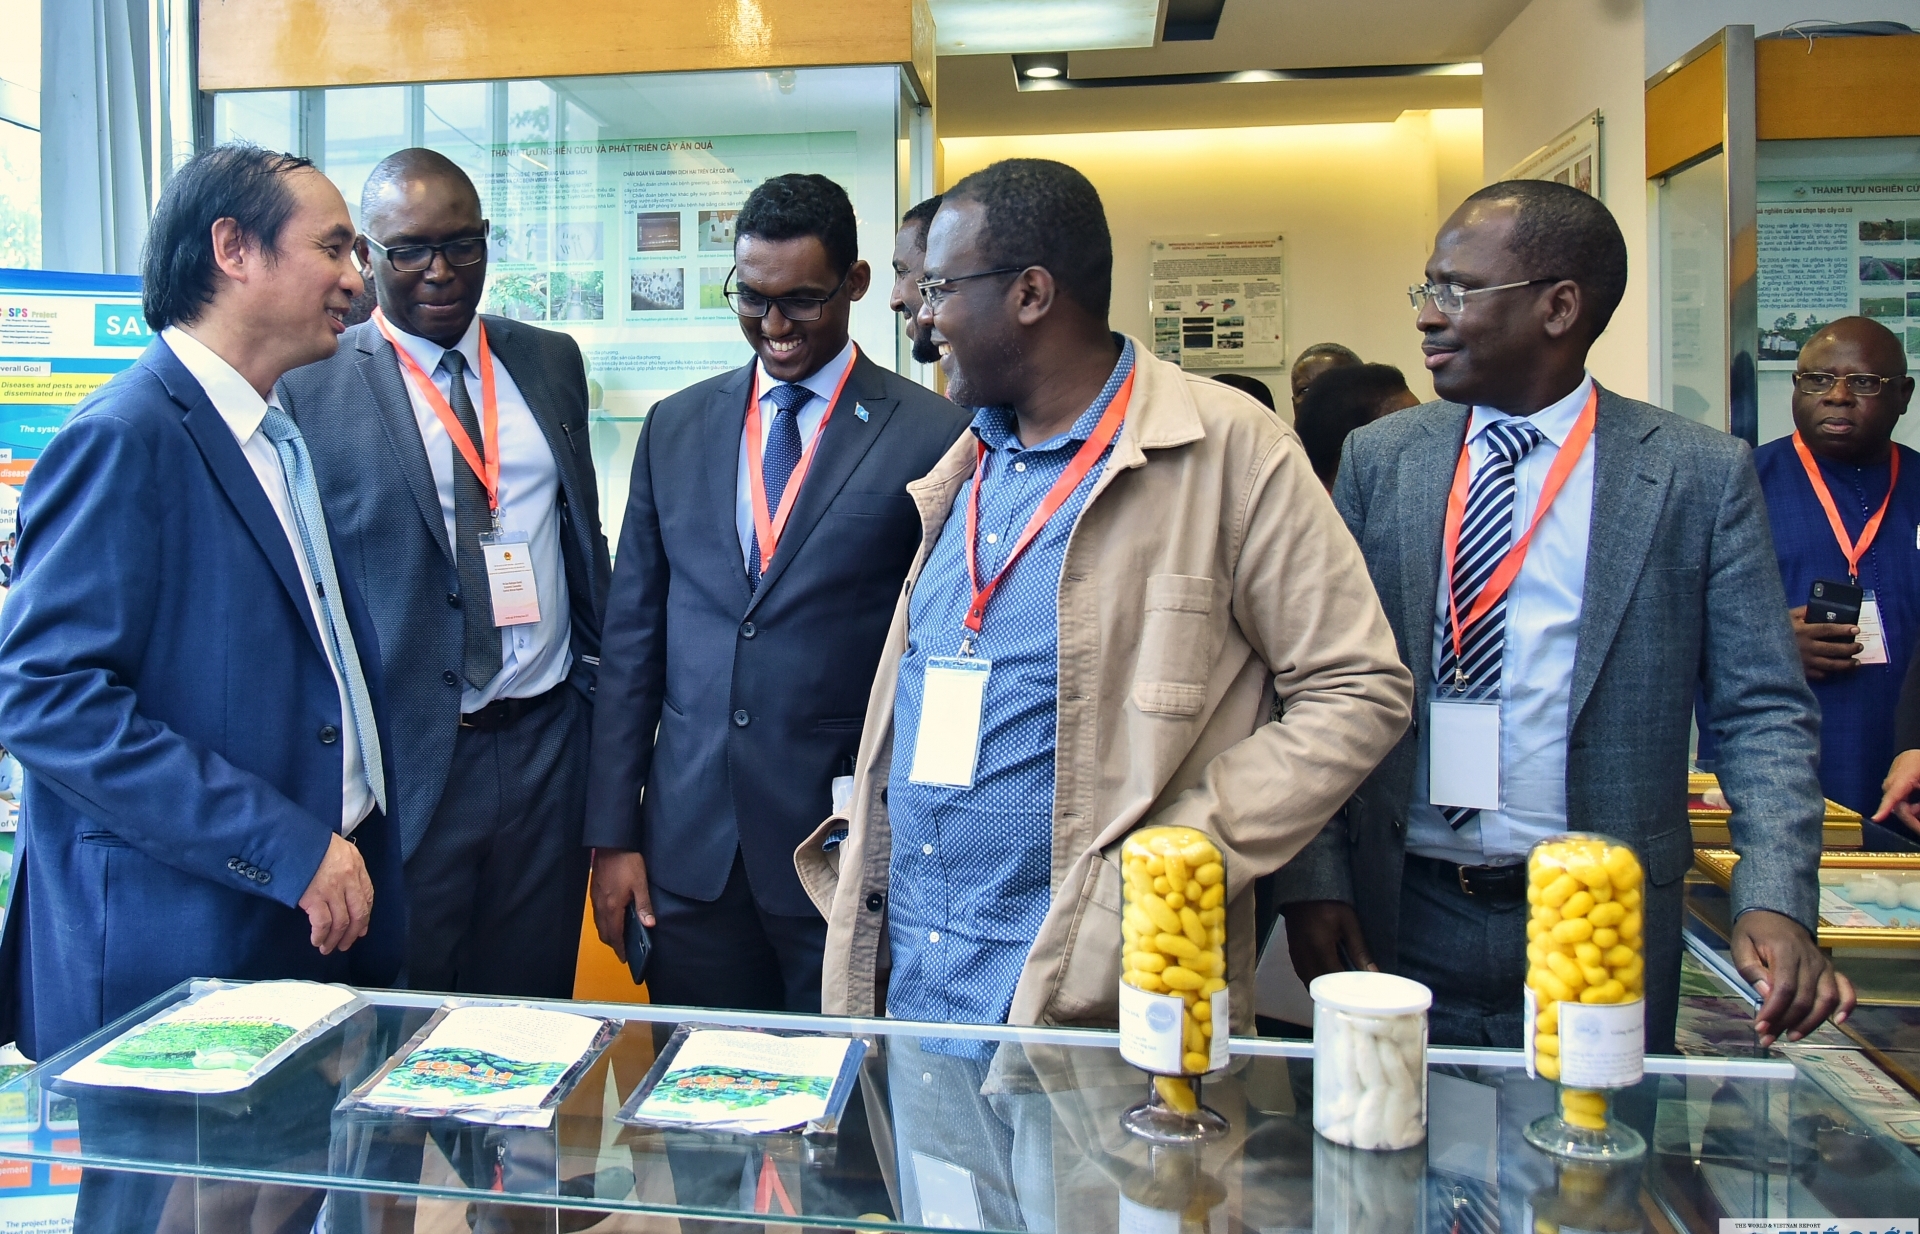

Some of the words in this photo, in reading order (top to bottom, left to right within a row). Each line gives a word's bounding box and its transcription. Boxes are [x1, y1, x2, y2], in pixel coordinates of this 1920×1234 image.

[608, 143, 632, 153] PHÁT
[660, 142, 678, 152] CÂY
[1868, 184, 1904, 194] NGHIÊN
[0, 1166, 28, 1175] gement
[22, 1220, 47, 1228] project
